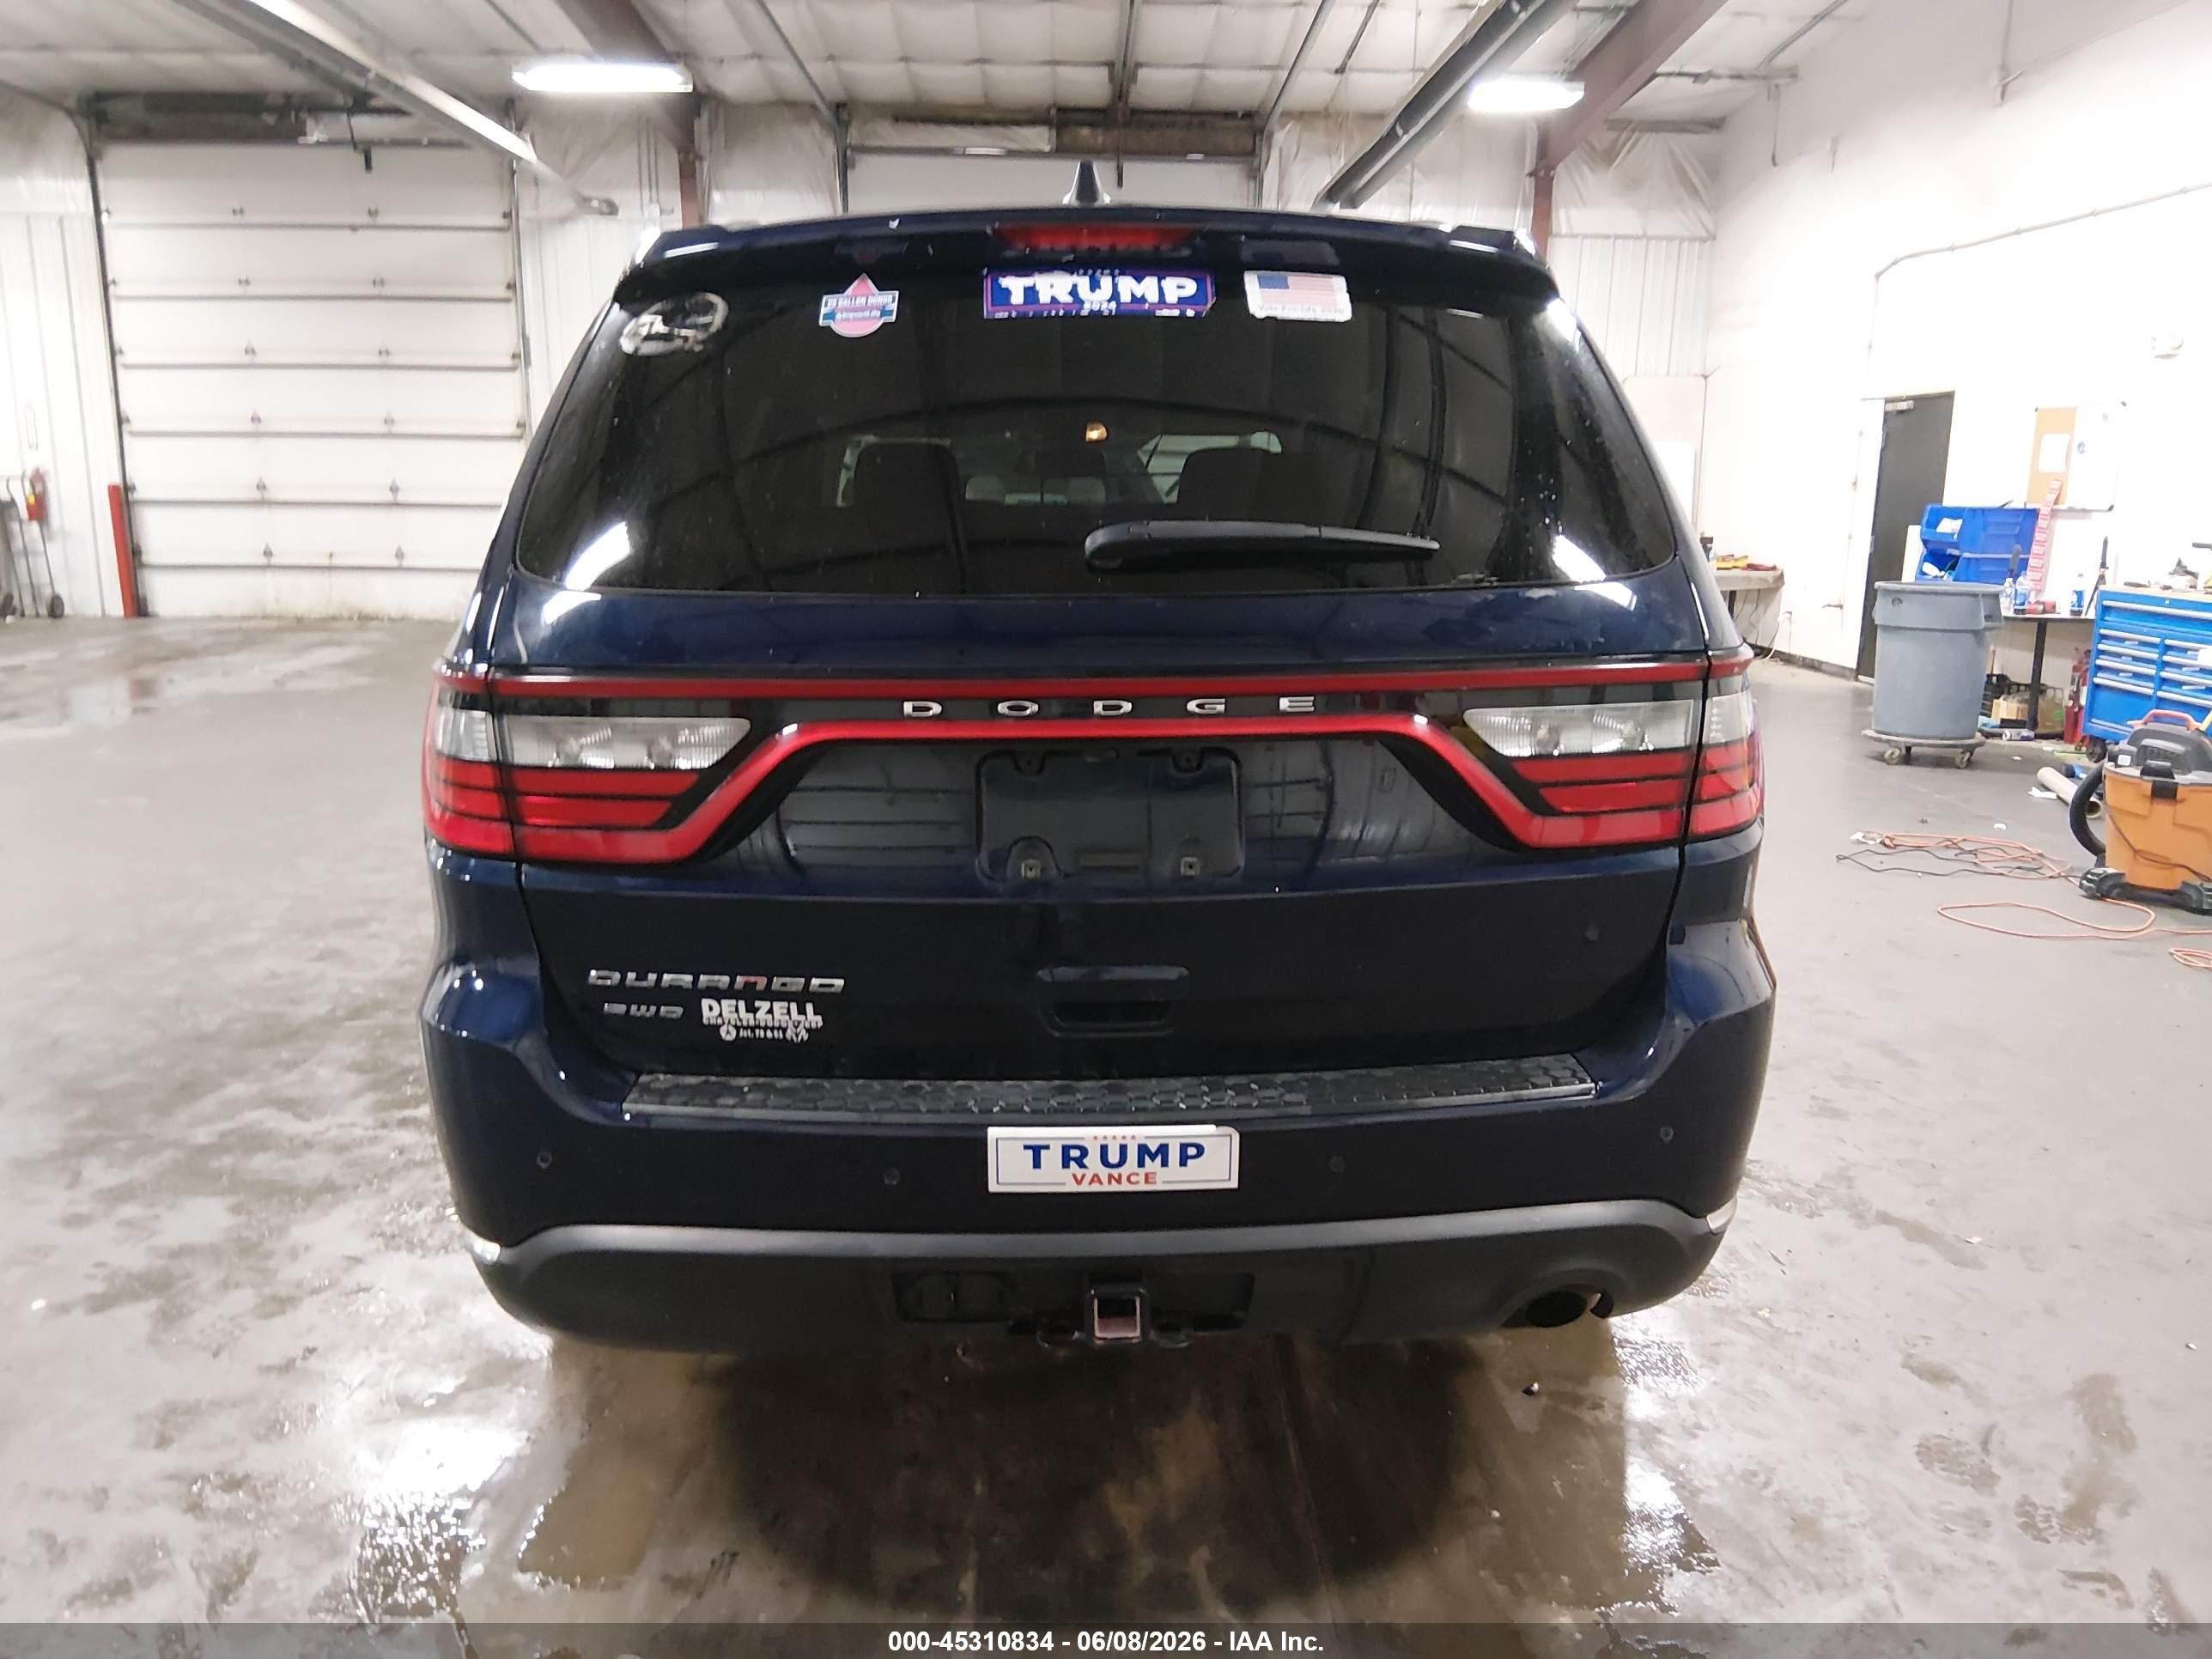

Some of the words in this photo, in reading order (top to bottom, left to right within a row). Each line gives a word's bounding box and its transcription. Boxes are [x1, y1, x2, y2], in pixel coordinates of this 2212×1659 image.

[999, 274, 1198, 305] TRUMP
[902, 696, 1315, 718] DODGE
[588, 969, 845, 994] DURANGO
[701, 998, 823, 1020] DELZELL
[1024, 1142, 1205, 1170] TRUMP
[1072, 1171, 1158, 1186] VANCE
